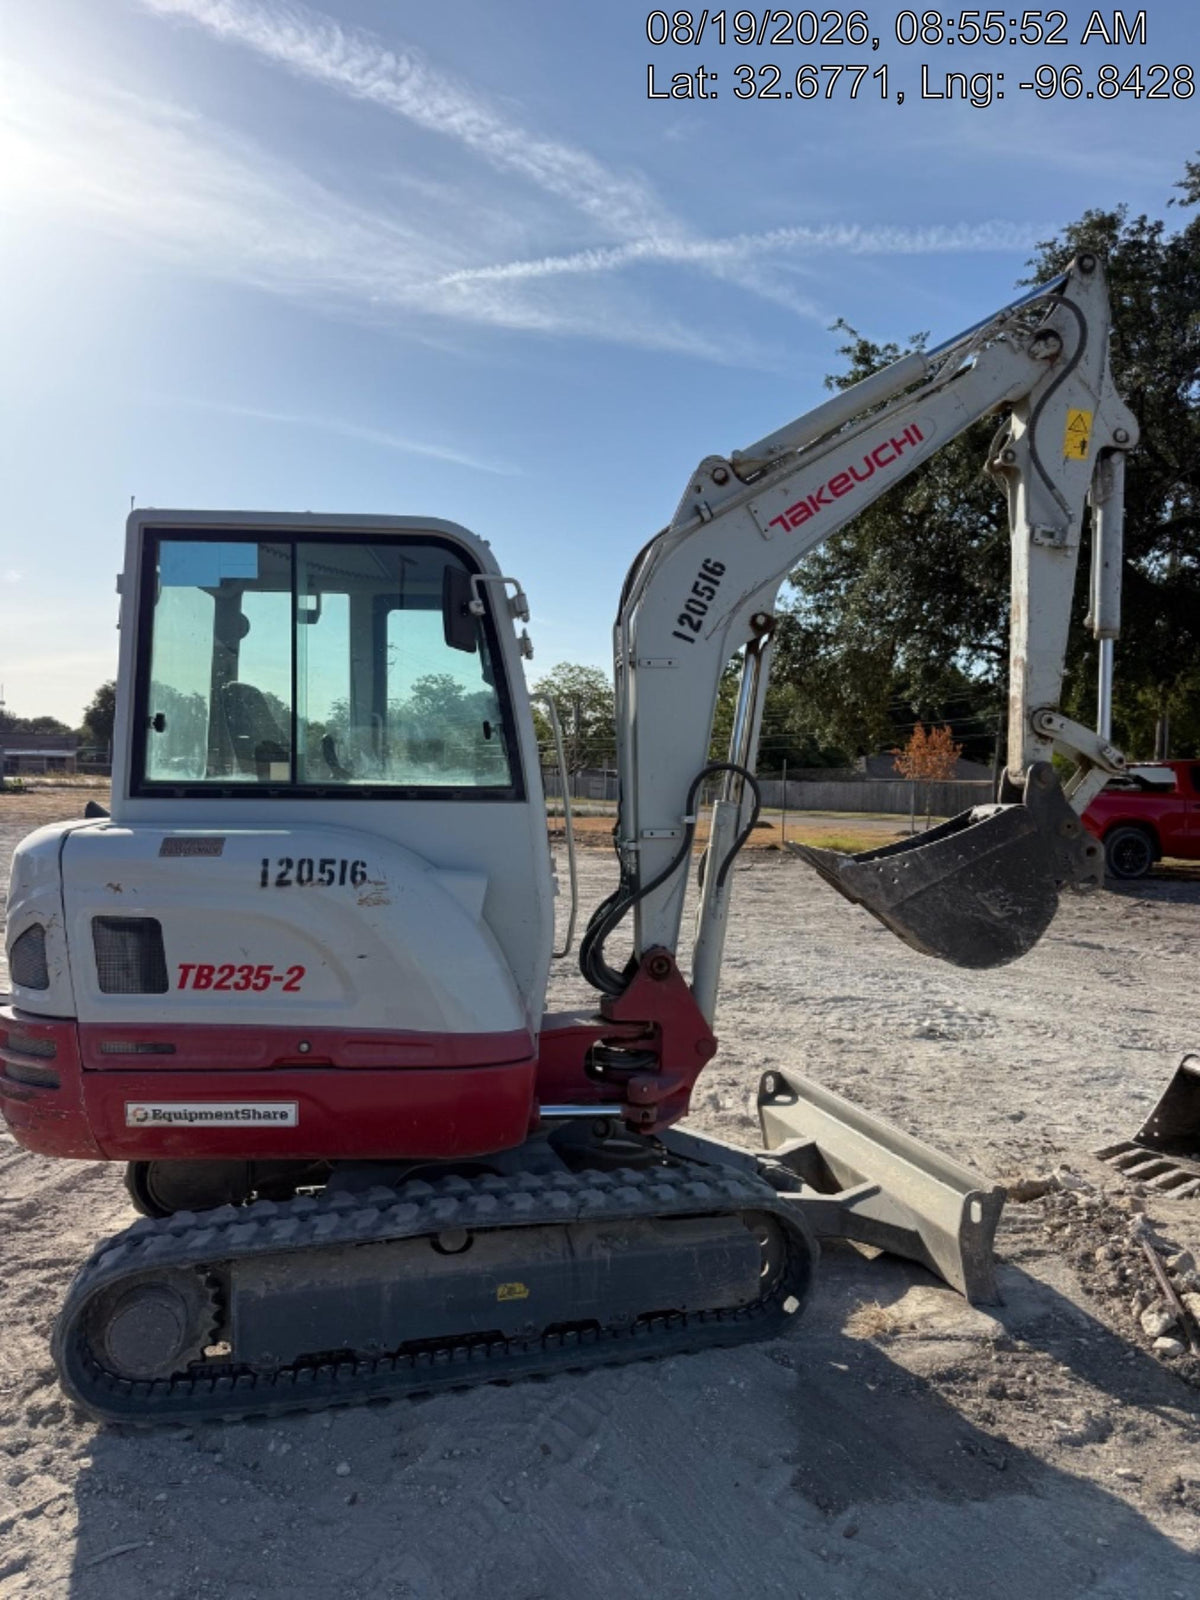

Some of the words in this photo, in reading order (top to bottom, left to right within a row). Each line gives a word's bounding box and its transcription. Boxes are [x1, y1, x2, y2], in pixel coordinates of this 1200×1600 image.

[672, 558, 726, 644] 120516
[260, 857, 367, 889] 120516
[177, 963, 306, 992] TB235-2
[152, 1108, 289, 1122] EquipmentShare
